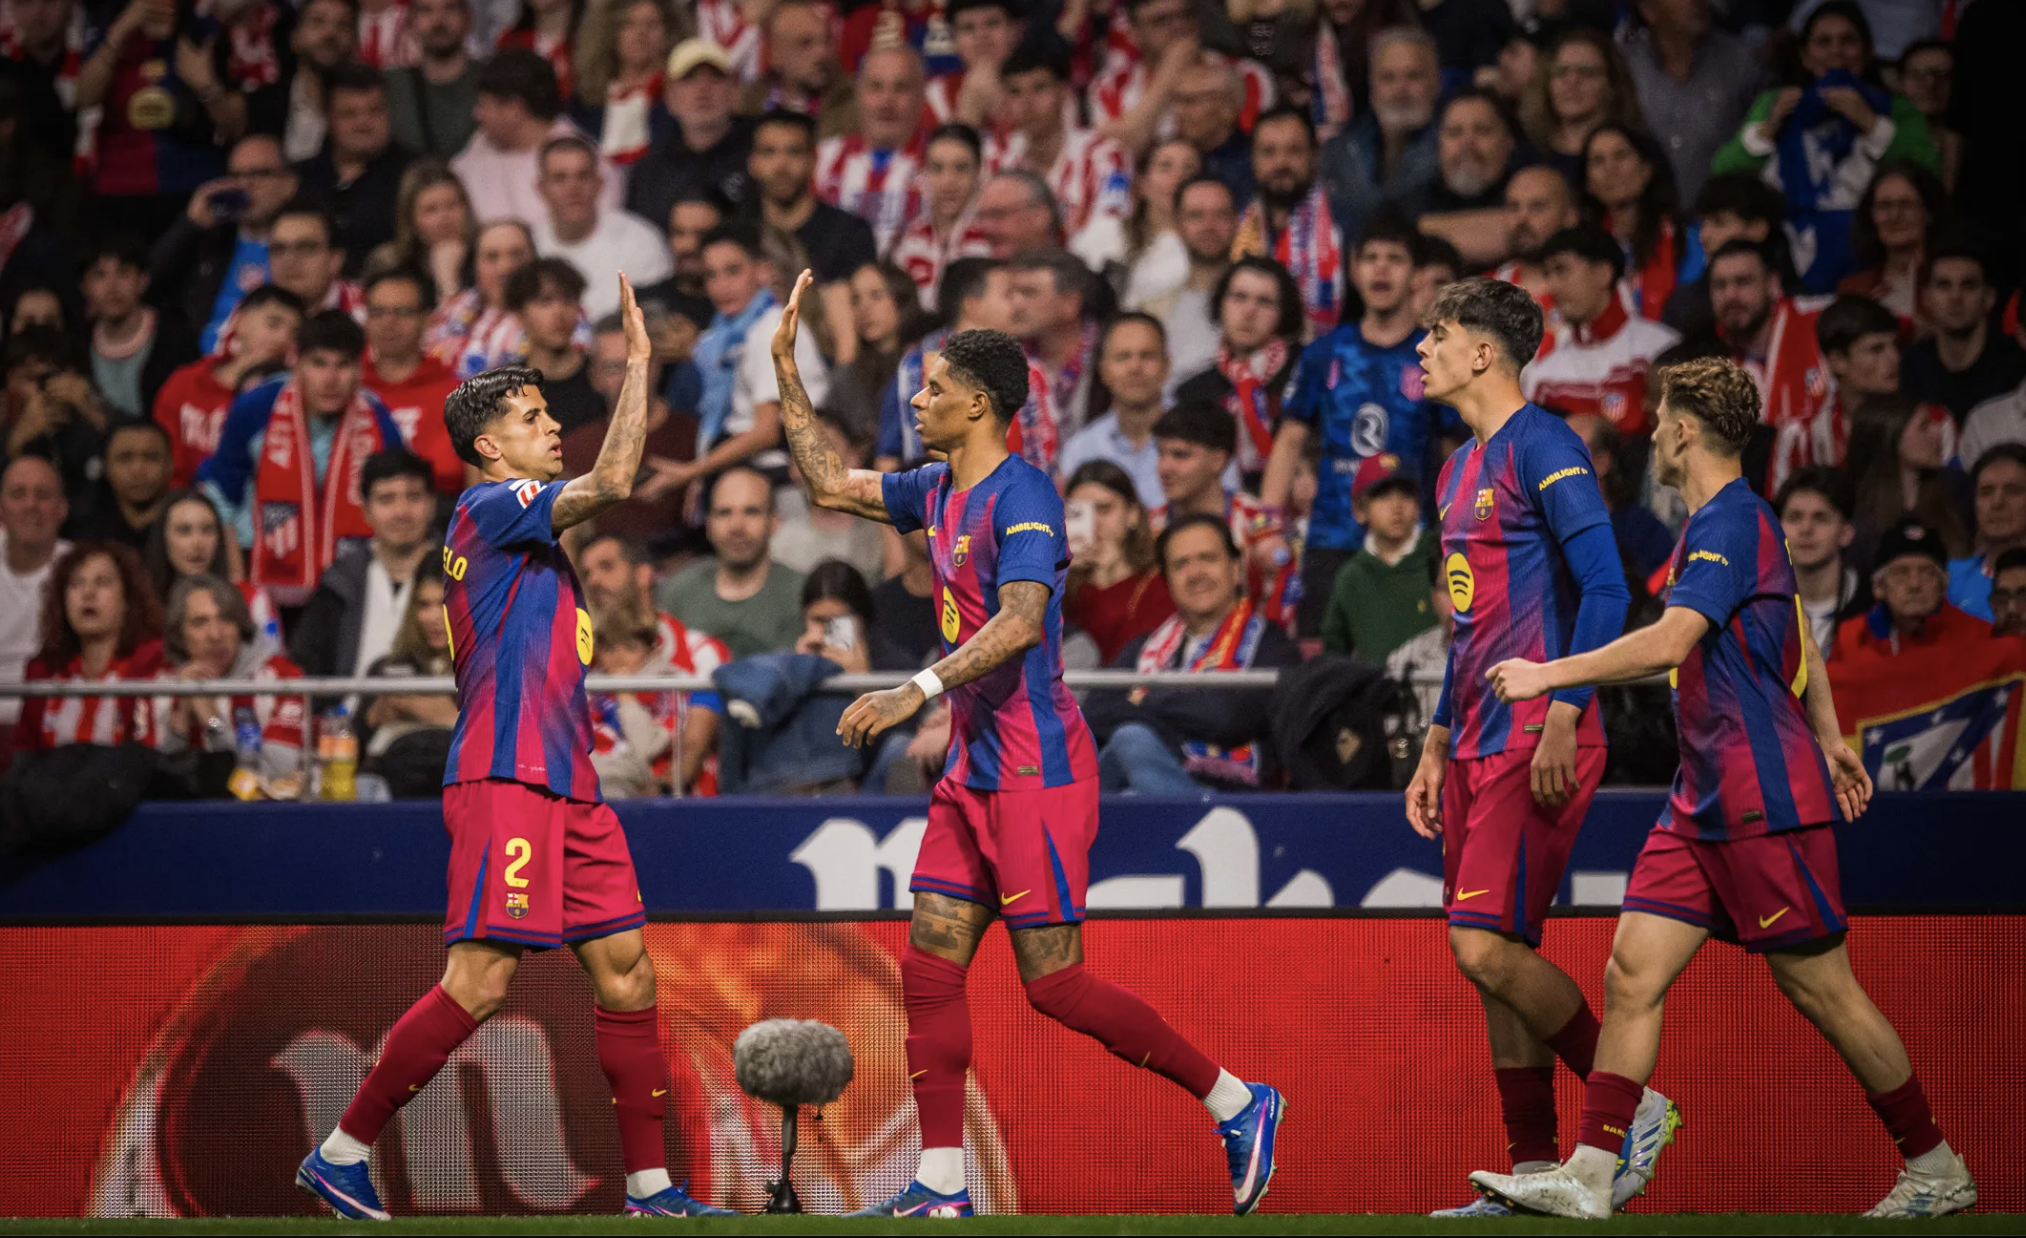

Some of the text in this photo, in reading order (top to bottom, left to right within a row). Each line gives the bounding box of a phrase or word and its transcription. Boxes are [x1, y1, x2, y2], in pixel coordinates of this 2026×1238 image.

[1539, 466, 1580, 491] AMBILIGHT
[1006, 522, 1050, 536] AMBILIGHT
[504, 837, 532, 888] 2
